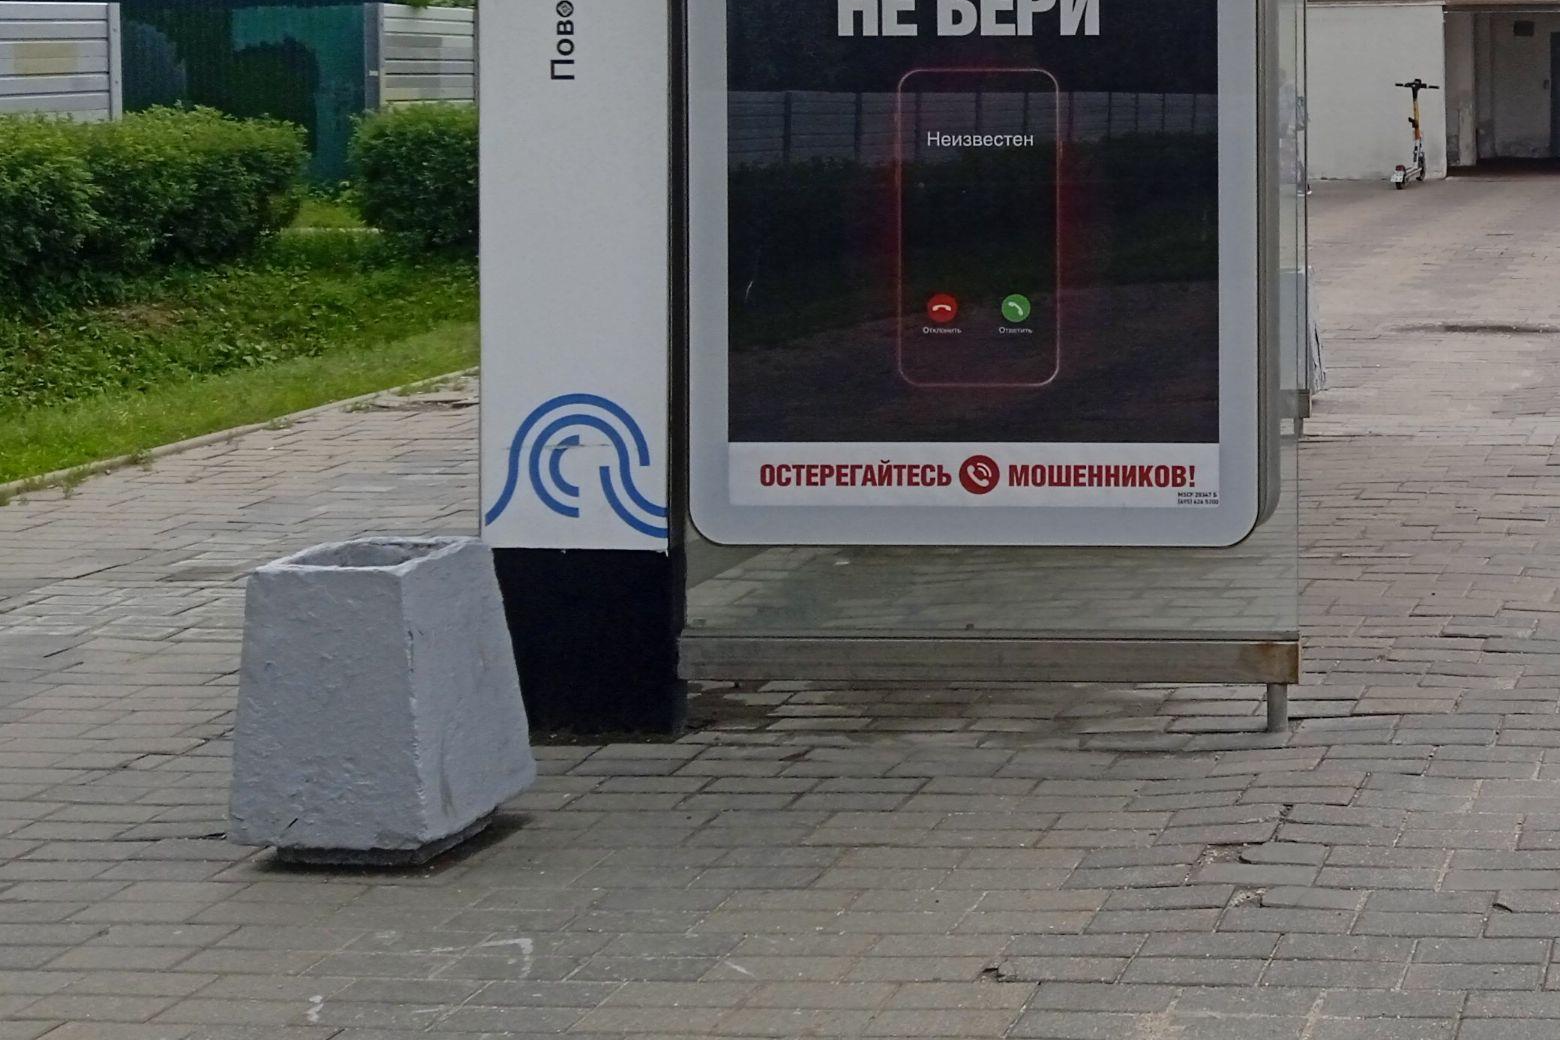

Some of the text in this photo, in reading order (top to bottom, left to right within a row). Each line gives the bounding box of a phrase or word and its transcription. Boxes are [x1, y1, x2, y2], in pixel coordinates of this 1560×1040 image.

[927, 131, 1034, 147] Неизвестен
[760, 459, 1195, 488] ОСТЕРЕГАЙТЕСЬ МОШЕННИКОВ!
